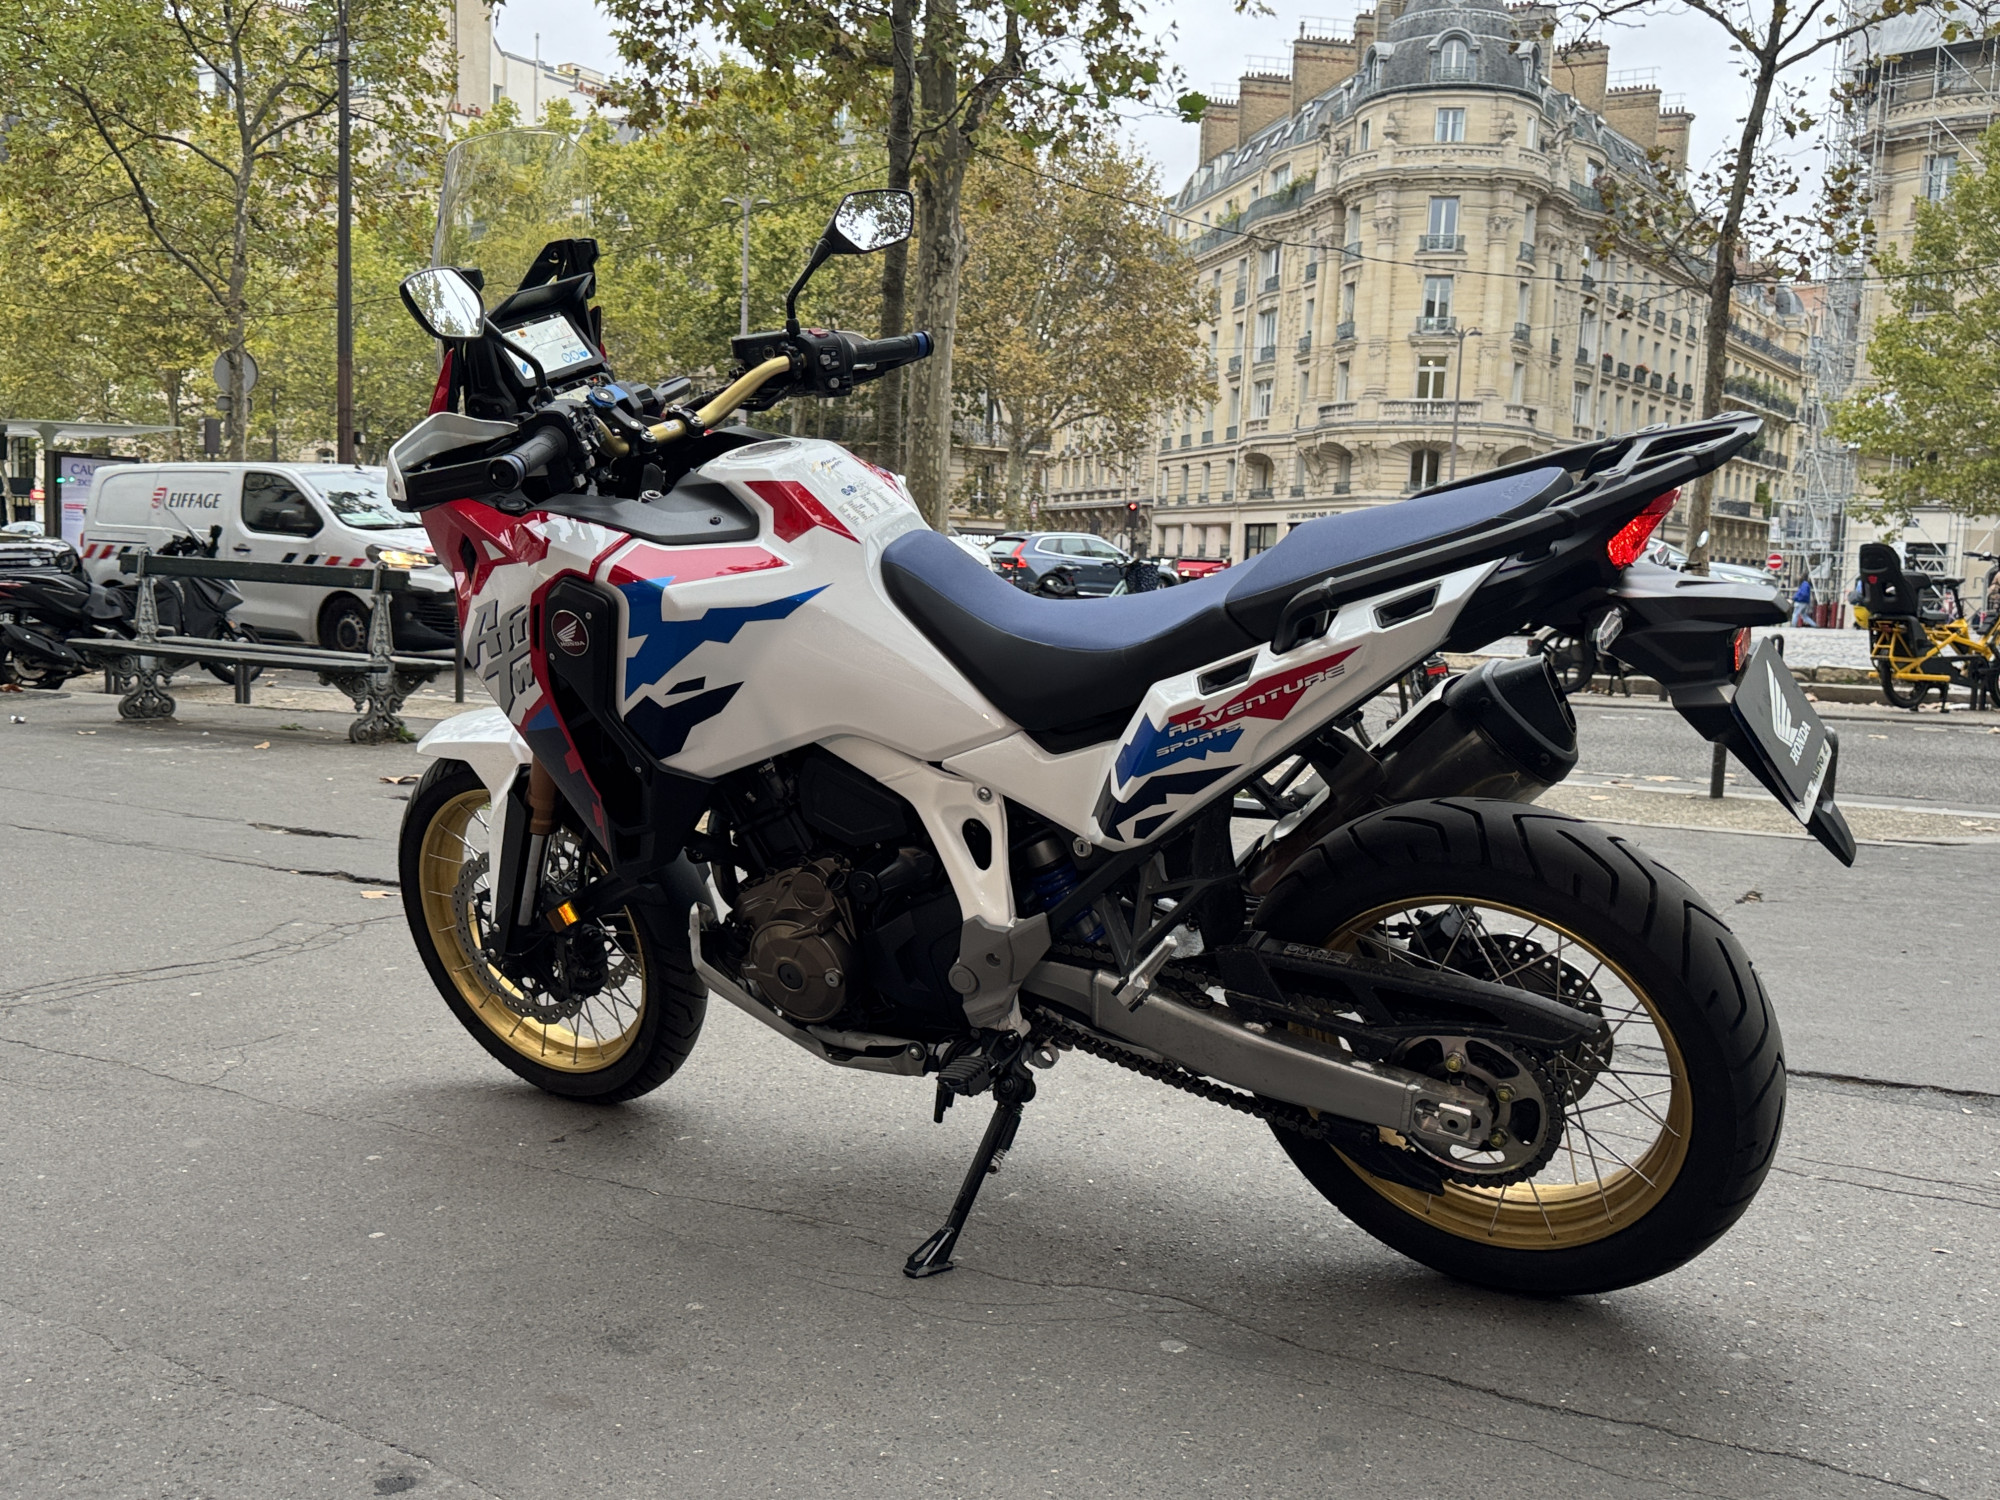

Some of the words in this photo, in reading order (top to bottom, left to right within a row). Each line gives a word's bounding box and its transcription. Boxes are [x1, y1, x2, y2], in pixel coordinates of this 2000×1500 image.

[71, 463, 97, 476] CAU
[168, 492, 222, 509] EIFFAGE
[1168, 663, 1346, 738] ADVENTURE
[1156, 722, 1242, 758] SPORTS
[1790, 720, 1811, 766] HONDA
